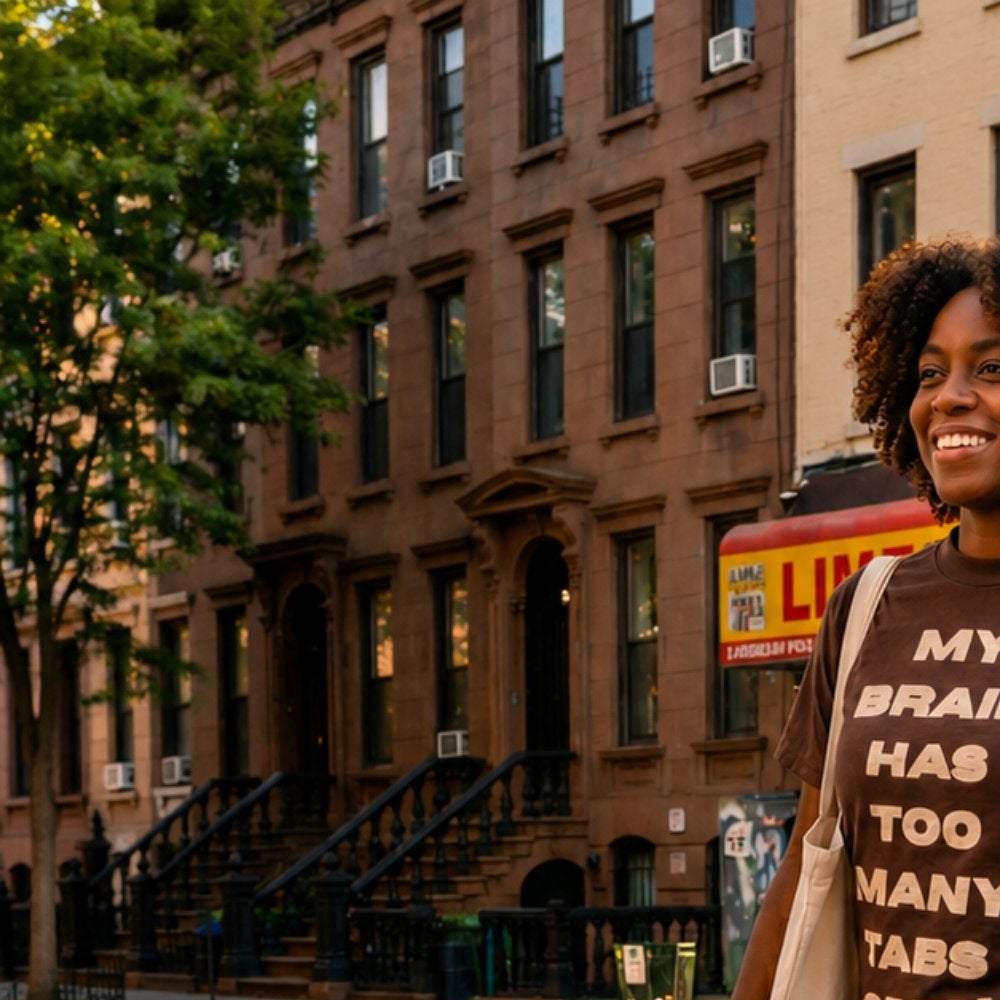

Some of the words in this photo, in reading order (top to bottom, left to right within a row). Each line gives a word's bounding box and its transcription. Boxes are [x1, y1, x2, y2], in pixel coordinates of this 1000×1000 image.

[865, 741, 988, 783] HAS
[870, 804, 982, 850] TOO
[864, 930, 988, 980] TABS
